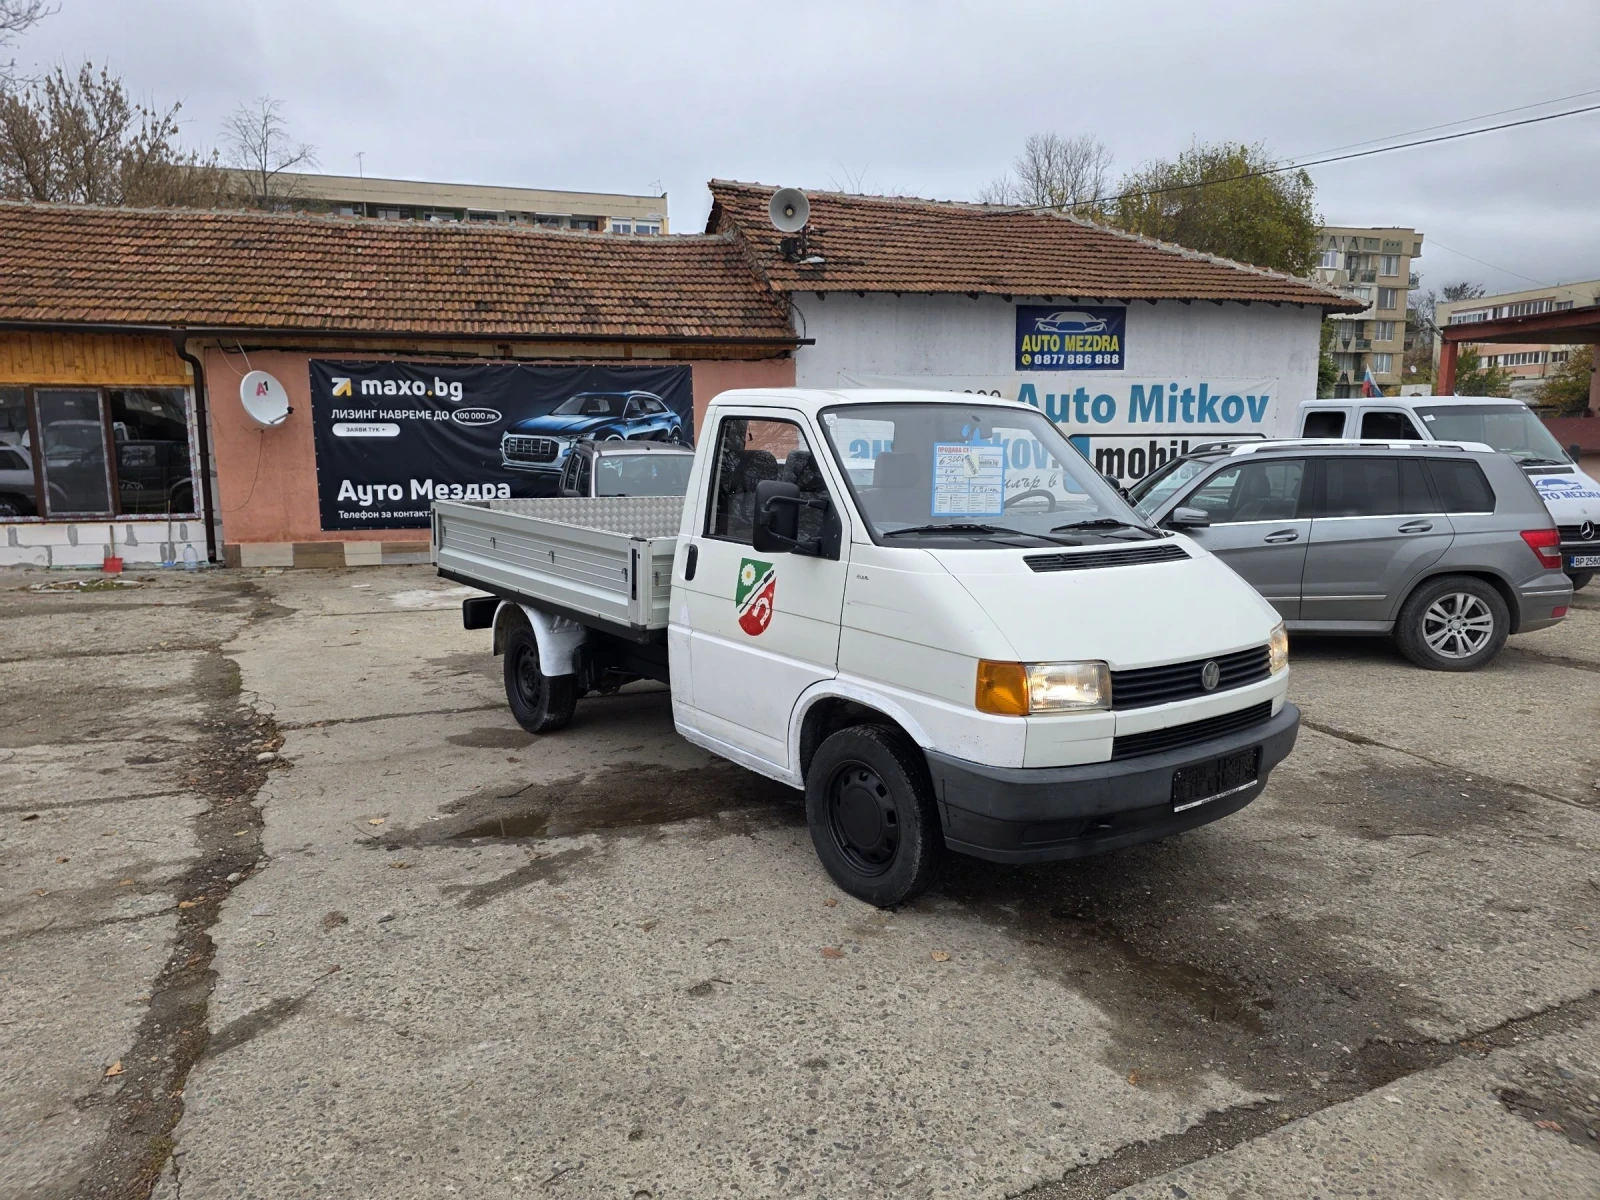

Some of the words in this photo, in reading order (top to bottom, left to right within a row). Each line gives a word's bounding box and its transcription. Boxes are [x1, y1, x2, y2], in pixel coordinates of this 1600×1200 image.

[1021, 334, 1060, 352] AUTO
[1065, 334, 1119, 352] MEZDRA
[1034, 354, 1064, 365] 0877
[1067, 354, 1092, 365] 886
[1095, 354, 1119, 365] 888
[256, 380, 269, 396] A1
[361, 376, 463, 402] maxo.bg
[1017, 382, 1116, 424] Auto
[1128, 382, 1270, 424] Mitkov
[331, 409, 377, 420] ЛИЗИНГ
[379, 409, 432, 420] НАВРЕМЕ
[433, 410, 450, 421] ДО
[456, 412, 470, 420] 100
[471, 412, 486, 420] 000
[337, 479, 403, 507] Ауто
[410, 479, 511, 500] Мездра
[338, 510, 379, 519] Телефон
